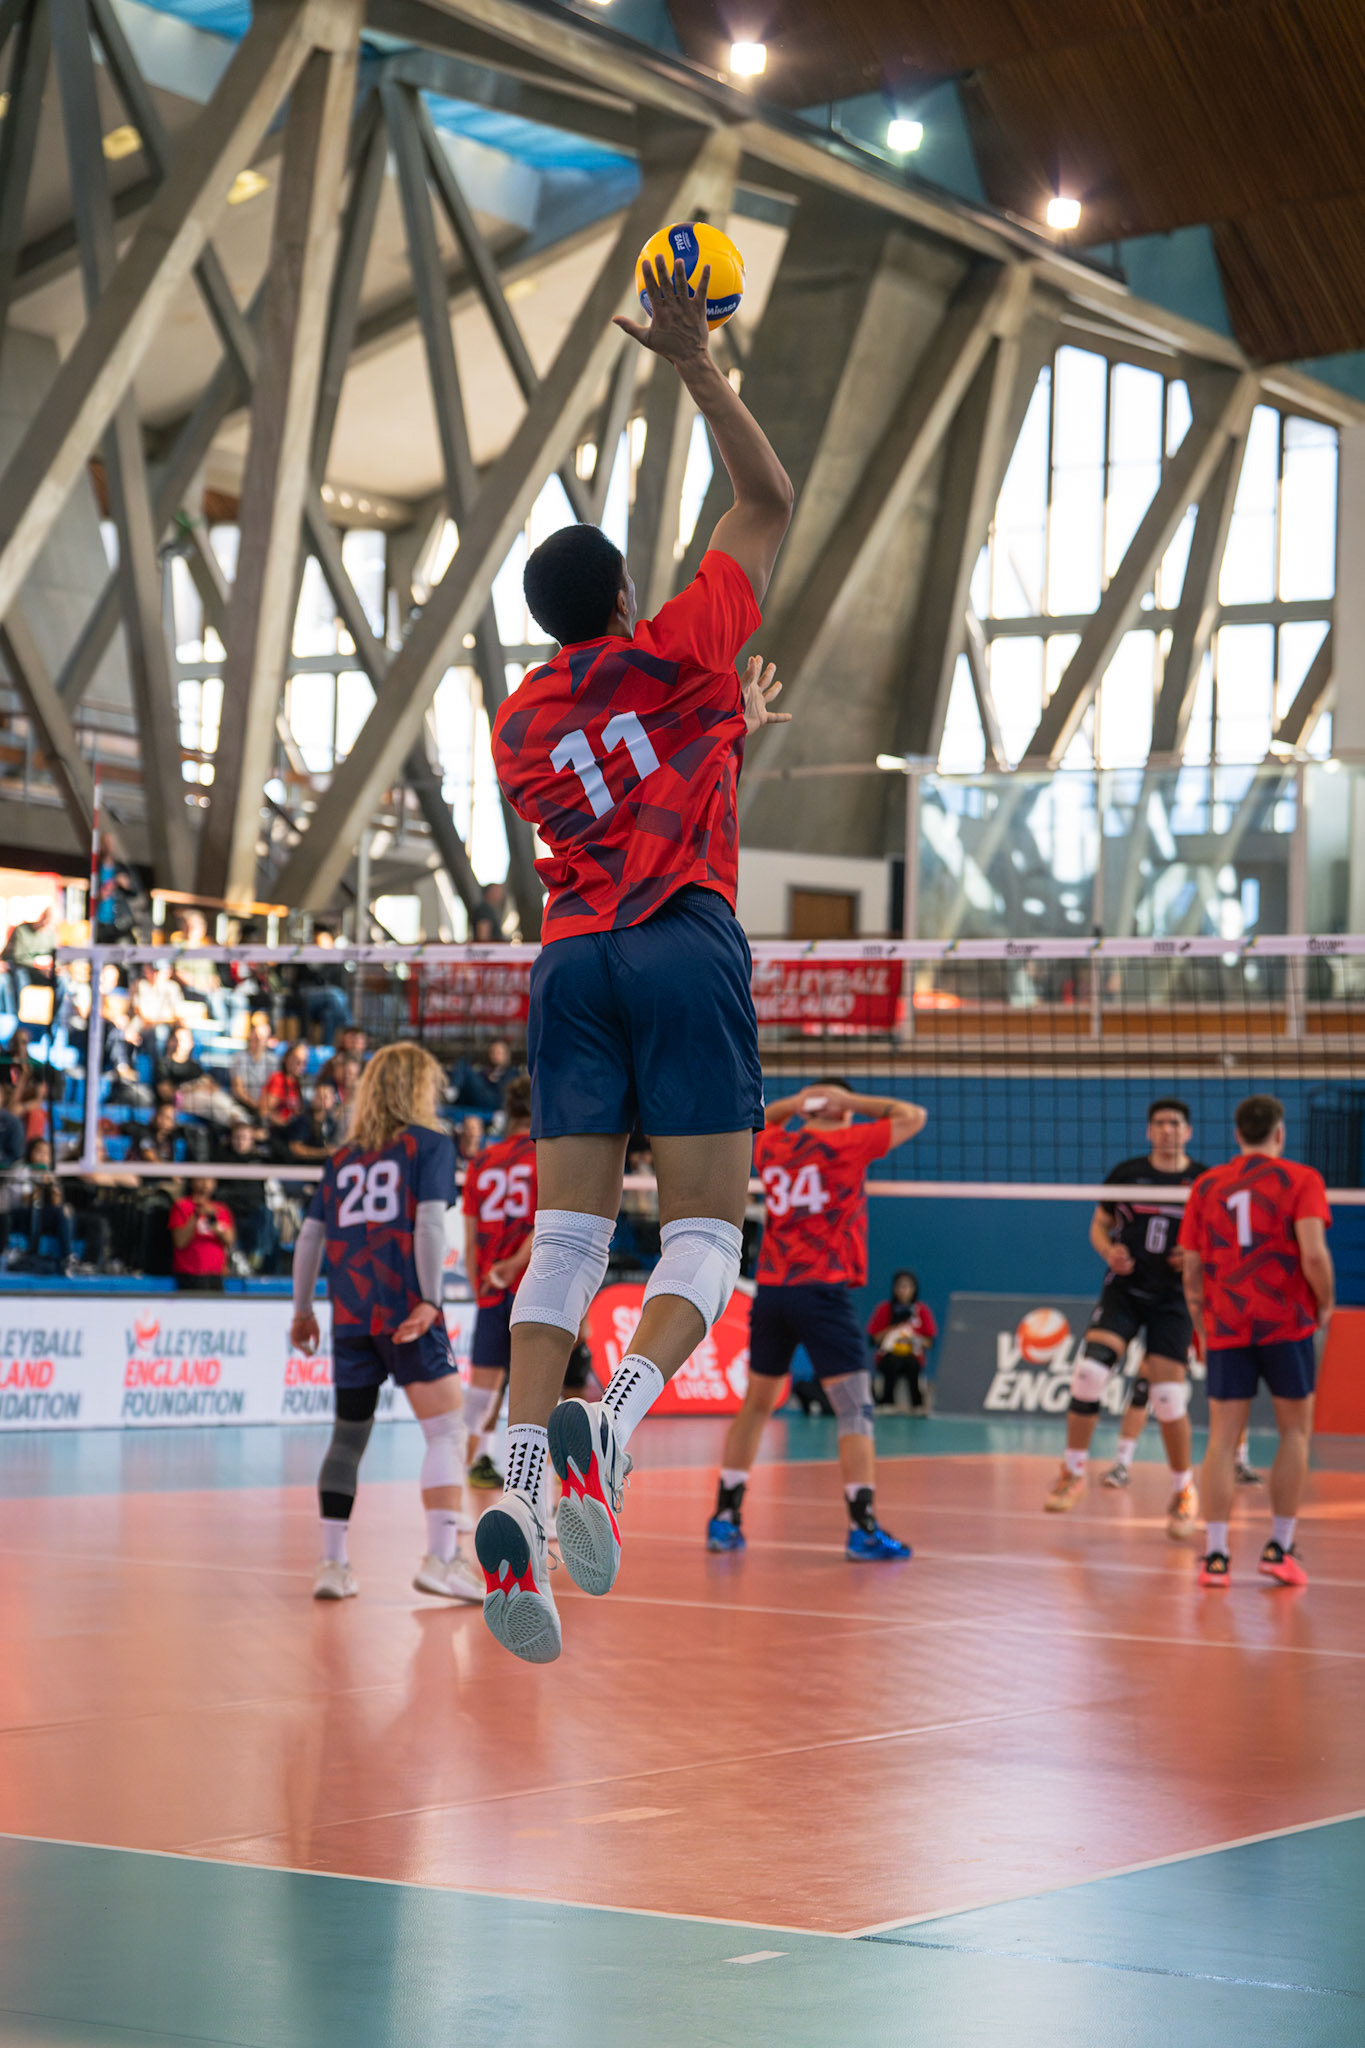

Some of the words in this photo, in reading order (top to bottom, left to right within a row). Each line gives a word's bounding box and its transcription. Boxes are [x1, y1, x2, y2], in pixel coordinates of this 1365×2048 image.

[549, 710, 661, 820] 11
[336, 1160, 400, 1228] 28
[477, 1163, 532, 1222] 25
[762, 1164, 831, 1216] 34
[1145, 1216, 1170, 1254] 6
[1226, 1189, 1253, 1247] 1
[123, 1358, 221, 1388] ENGLAND
[284, 1357, 333, 1387] ENGL
[637, 1358, 656, 1374] EDGE
[121, 1390, 245, 1418] FOUNDATION
